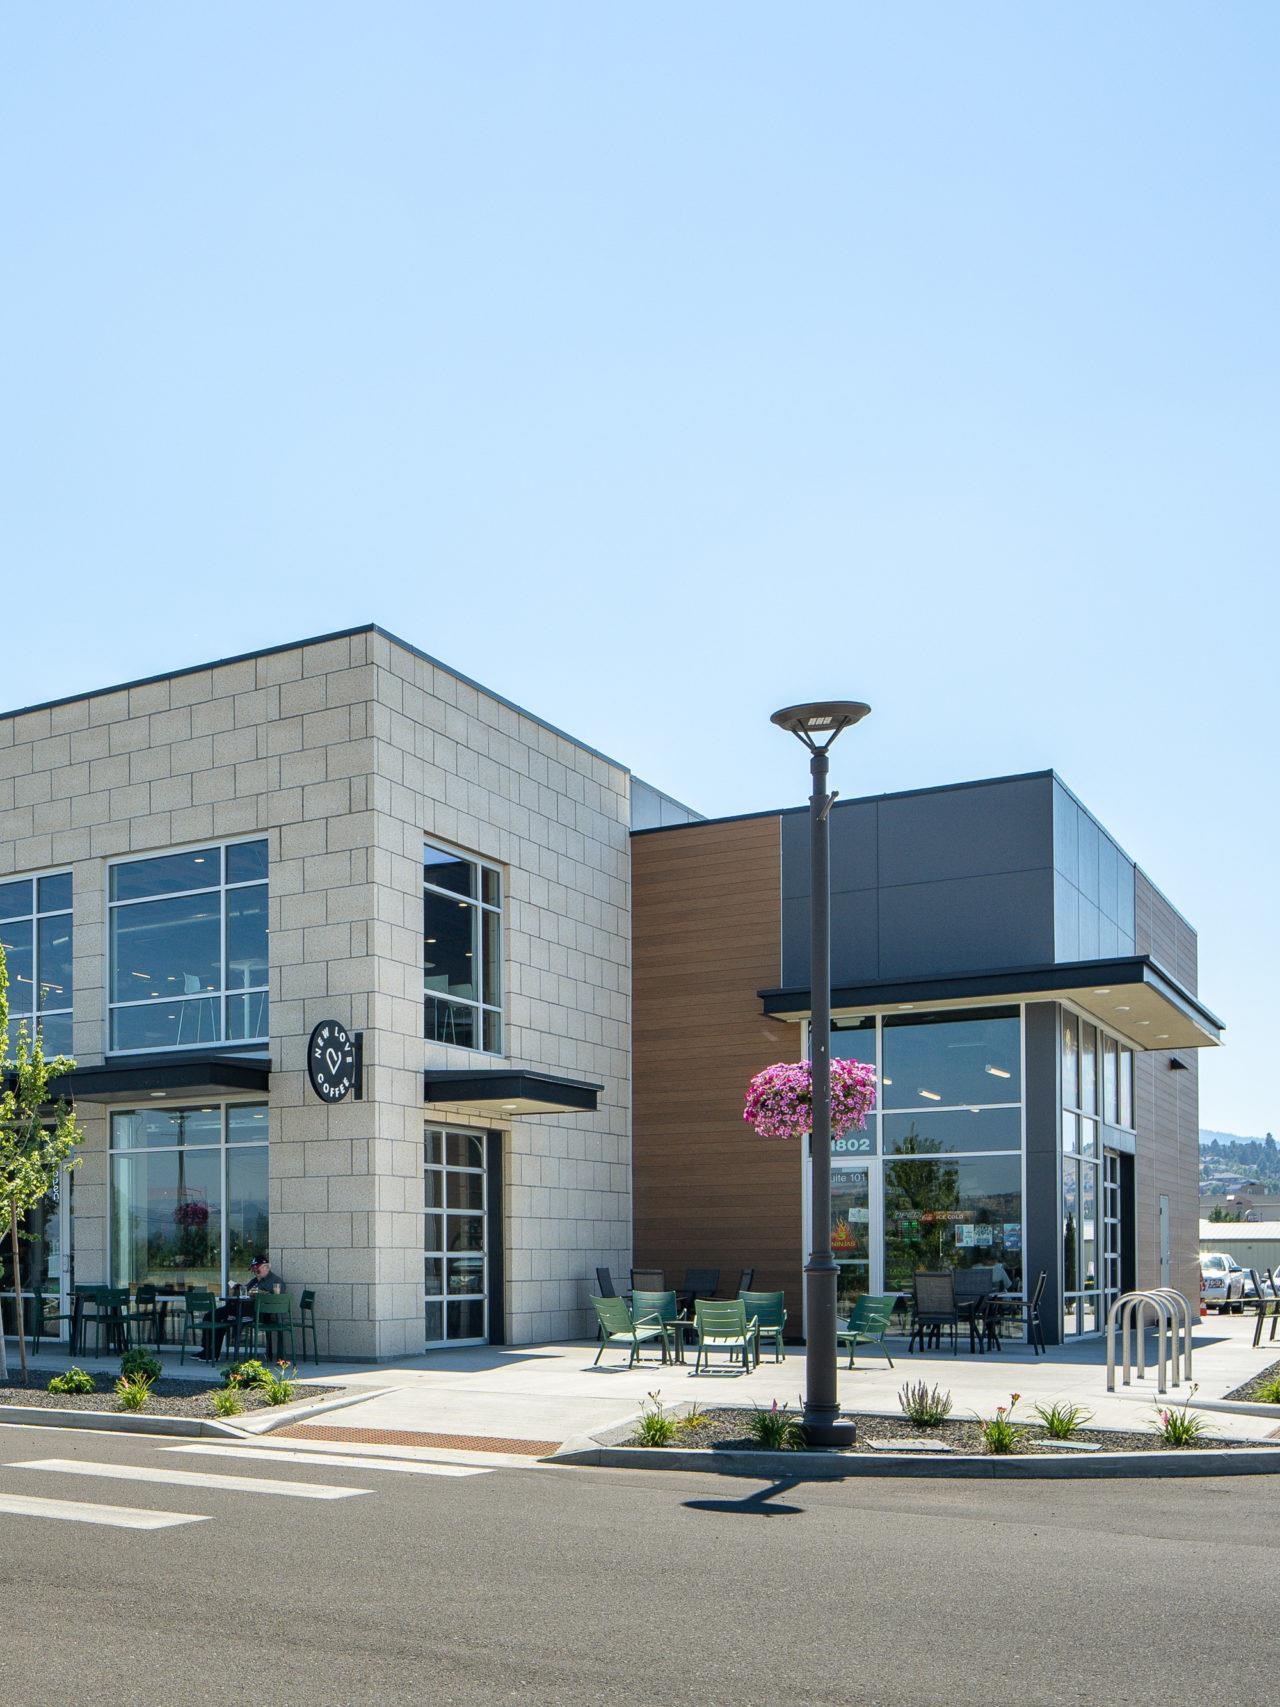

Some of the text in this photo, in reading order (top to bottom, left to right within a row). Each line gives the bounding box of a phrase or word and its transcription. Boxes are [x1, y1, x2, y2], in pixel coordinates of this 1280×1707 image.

[314, 1026, 353, 1063] NEW LOVE
[317, 1073, 350, 1097] COFFEE
[850, 1173, 866, 1182] 101
